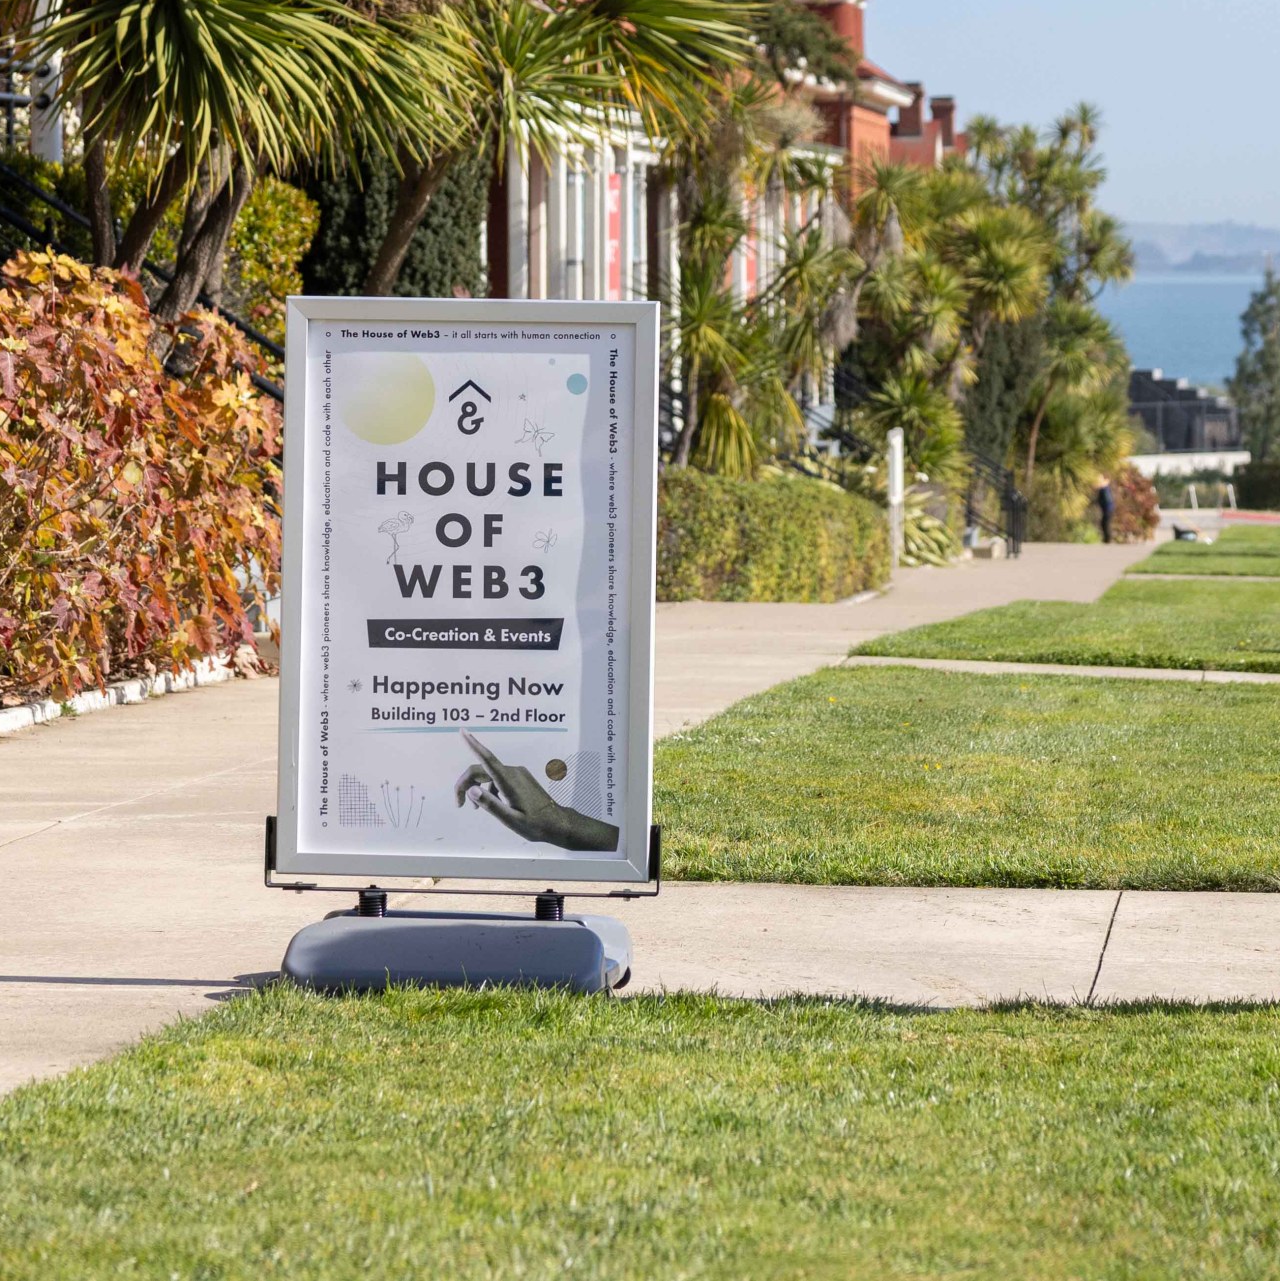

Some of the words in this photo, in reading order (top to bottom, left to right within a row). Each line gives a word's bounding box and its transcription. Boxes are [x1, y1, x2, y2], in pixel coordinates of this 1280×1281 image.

[341, 329, 358, 339] The
[362, 329, 393, 340] House
[397, 329, 408, 339] of
[411, 329, 440, 340] Web3
[452, 330, 458, 339] it
[461, 330, 472, 340] all
[474, 331, 498, 340] starts
[501, 330, 519, 340] with
[522, 330, 550, 340] human
[553, 331, 600, 341] connection
[322, 349, 331, 375] other
[609, 348, 619, 368] The
[322, 377, 331, 399] each
[609, 371, 618, 404] House
[322, 403, 331, 421] with
[609, 408, 618, 419] of
[322, 424, 331, 448] code
[609, 422, 618, 454] Web3
[322, 450, 331, 468] and
[377, 462, 562, 497] HOUSE
[608, 463, 618, 492] where
[322, 470, 331, 515] education
[608, 494, 618, 520] web3
[436, 513, 503, 547] OF
[606, 523, 617, 562] pioneers
[321, 519, 333, 572] knowledge,
[321, 575, 330, 599] share
[394, 565, 545, 599] WEB3
[608, 565, 617, 590] share
[320, 603, 331, 643] pioneers
[605, 593, 617, 647] knowledge,
[384, 627, 479, 642] Co-Creation
[484, 629, 496, 642] &
[501, 629, 552, 643] Events
[321, 645, 330, 672] web3
[607, 650, 616, 695] education
[320, 674, 329, 702] where
[373, 675, 500, 700] Happening
[508, 677, 564, 695] Now
[371, 707, 436, 724] Building
[443, 708, 470, 722] 103
[489, 708, 520, 722] 2nd
[525, 709, 565, 722] Floor
[607, 698, 616, 716] and
[320, 711, 329, 743] Web3
[607, 719, 616, 741] code
[320, 745, 329, 758] of
[607, 745, 616, 763] with
[320, 760, 329, 794] House
[607, 767, 616, 789] each
[320, 797, 329, 816] The
[606, 792, 615, 817] other
